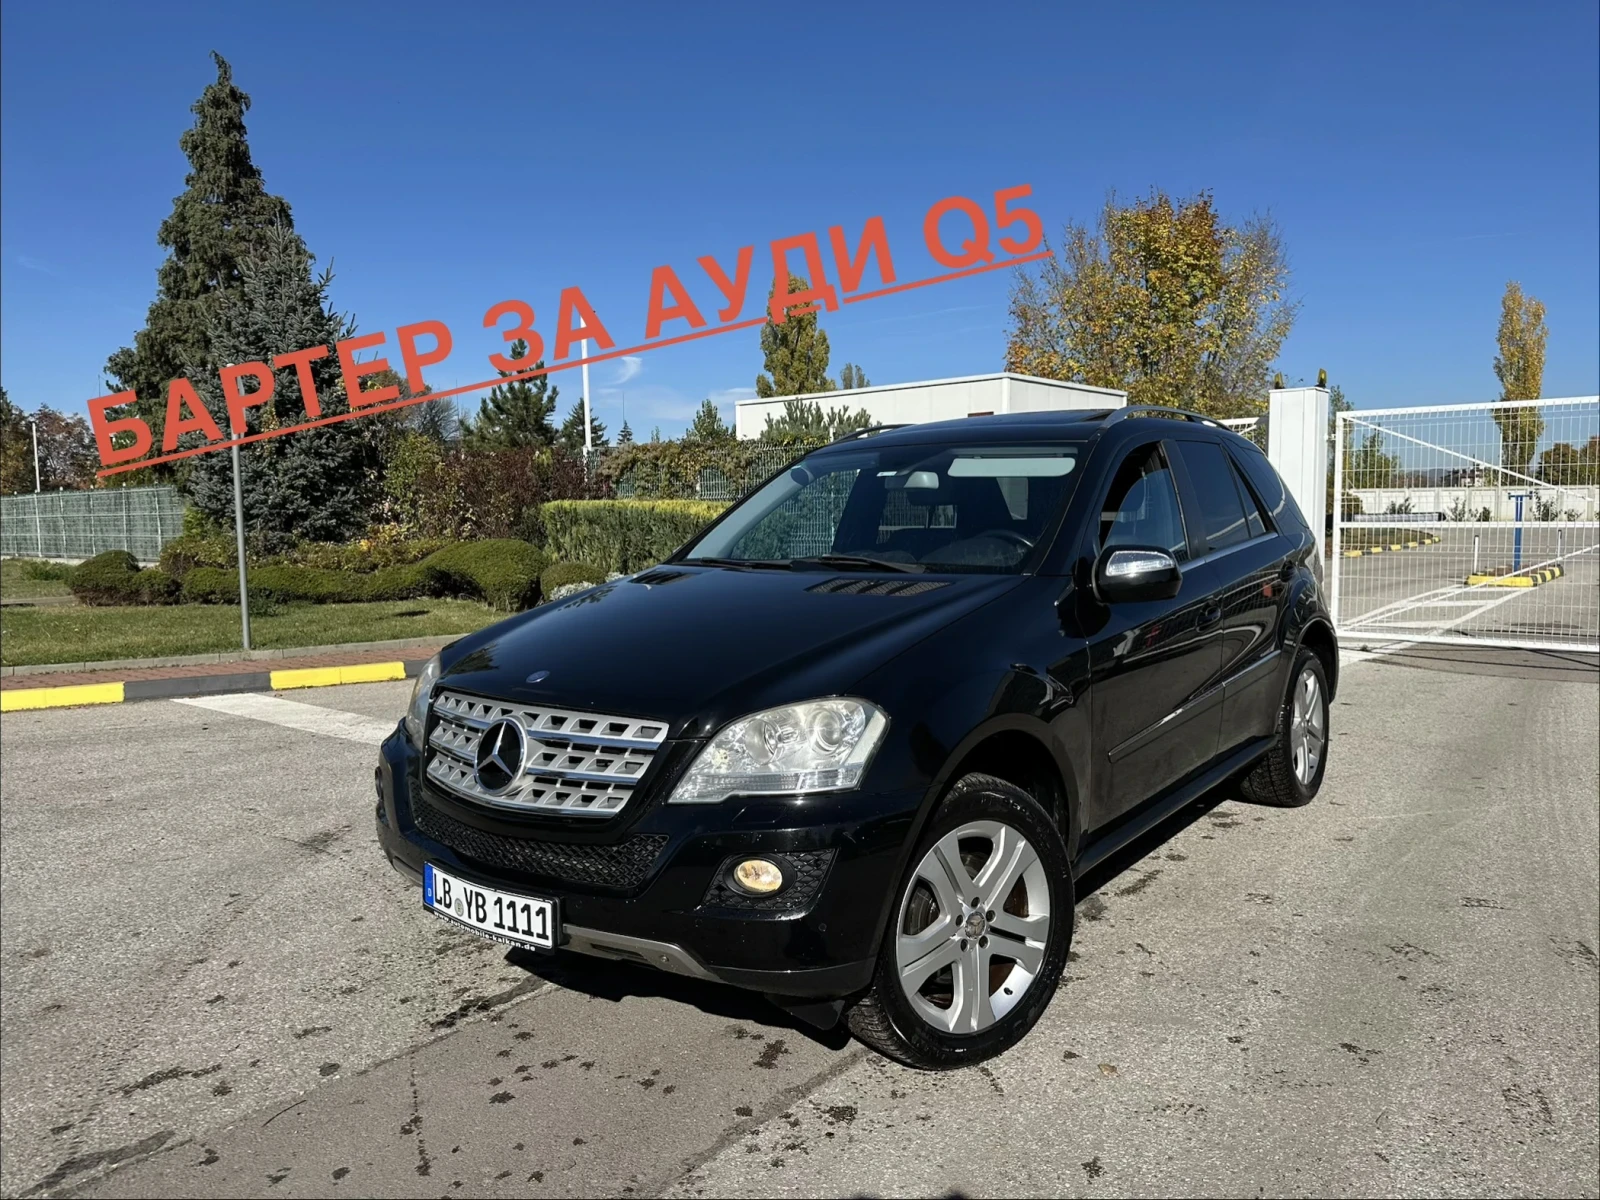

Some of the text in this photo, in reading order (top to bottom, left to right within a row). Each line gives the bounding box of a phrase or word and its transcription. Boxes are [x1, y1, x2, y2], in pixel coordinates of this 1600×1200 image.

[433, 873, 549, 940] LB YB 1111
